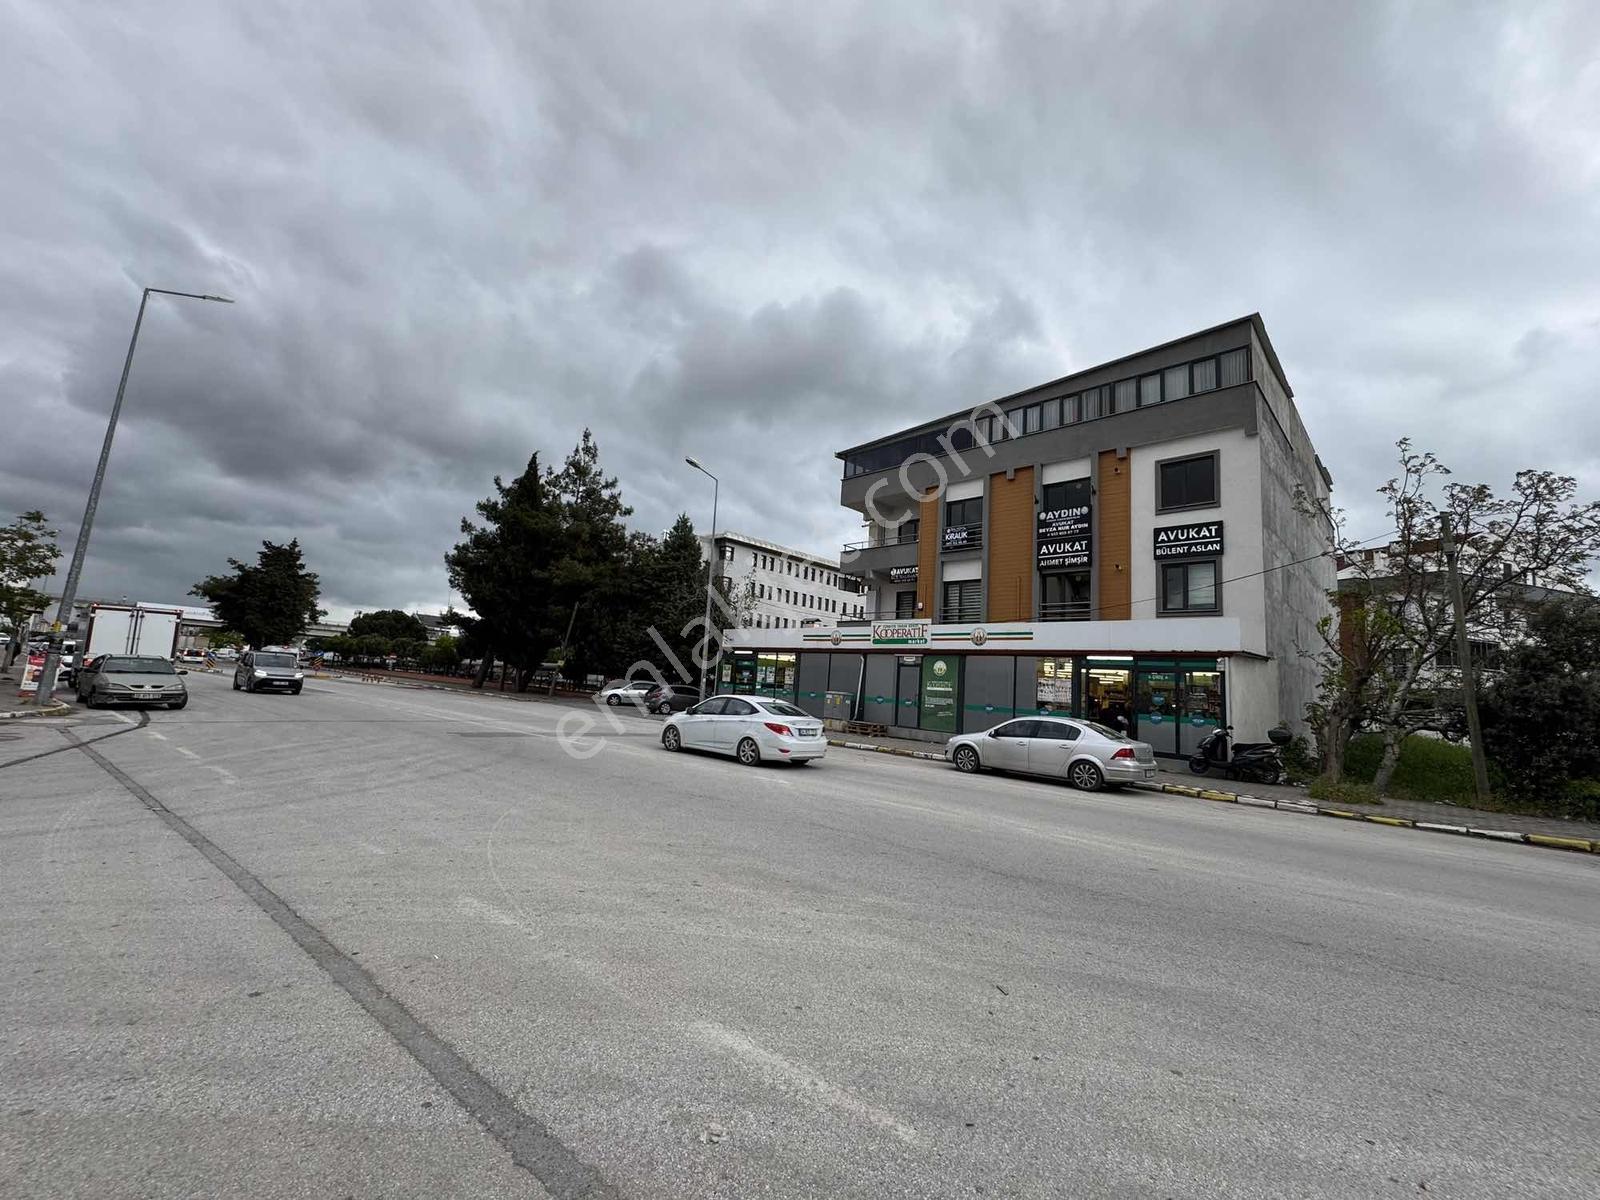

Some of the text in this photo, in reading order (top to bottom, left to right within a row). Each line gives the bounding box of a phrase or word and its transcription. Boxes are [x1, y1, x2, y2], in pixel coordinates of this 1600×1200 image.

[1046, 507, 1080, 519] AYDIN
[1158, 525, 1219, 542] AVUKAT
[1040, 540, 1087, 554] AVUKAT
[1156, 543, 1219, 555] BÜLENT ASLAN
[1040, 558, 1063, 567] AHMET
